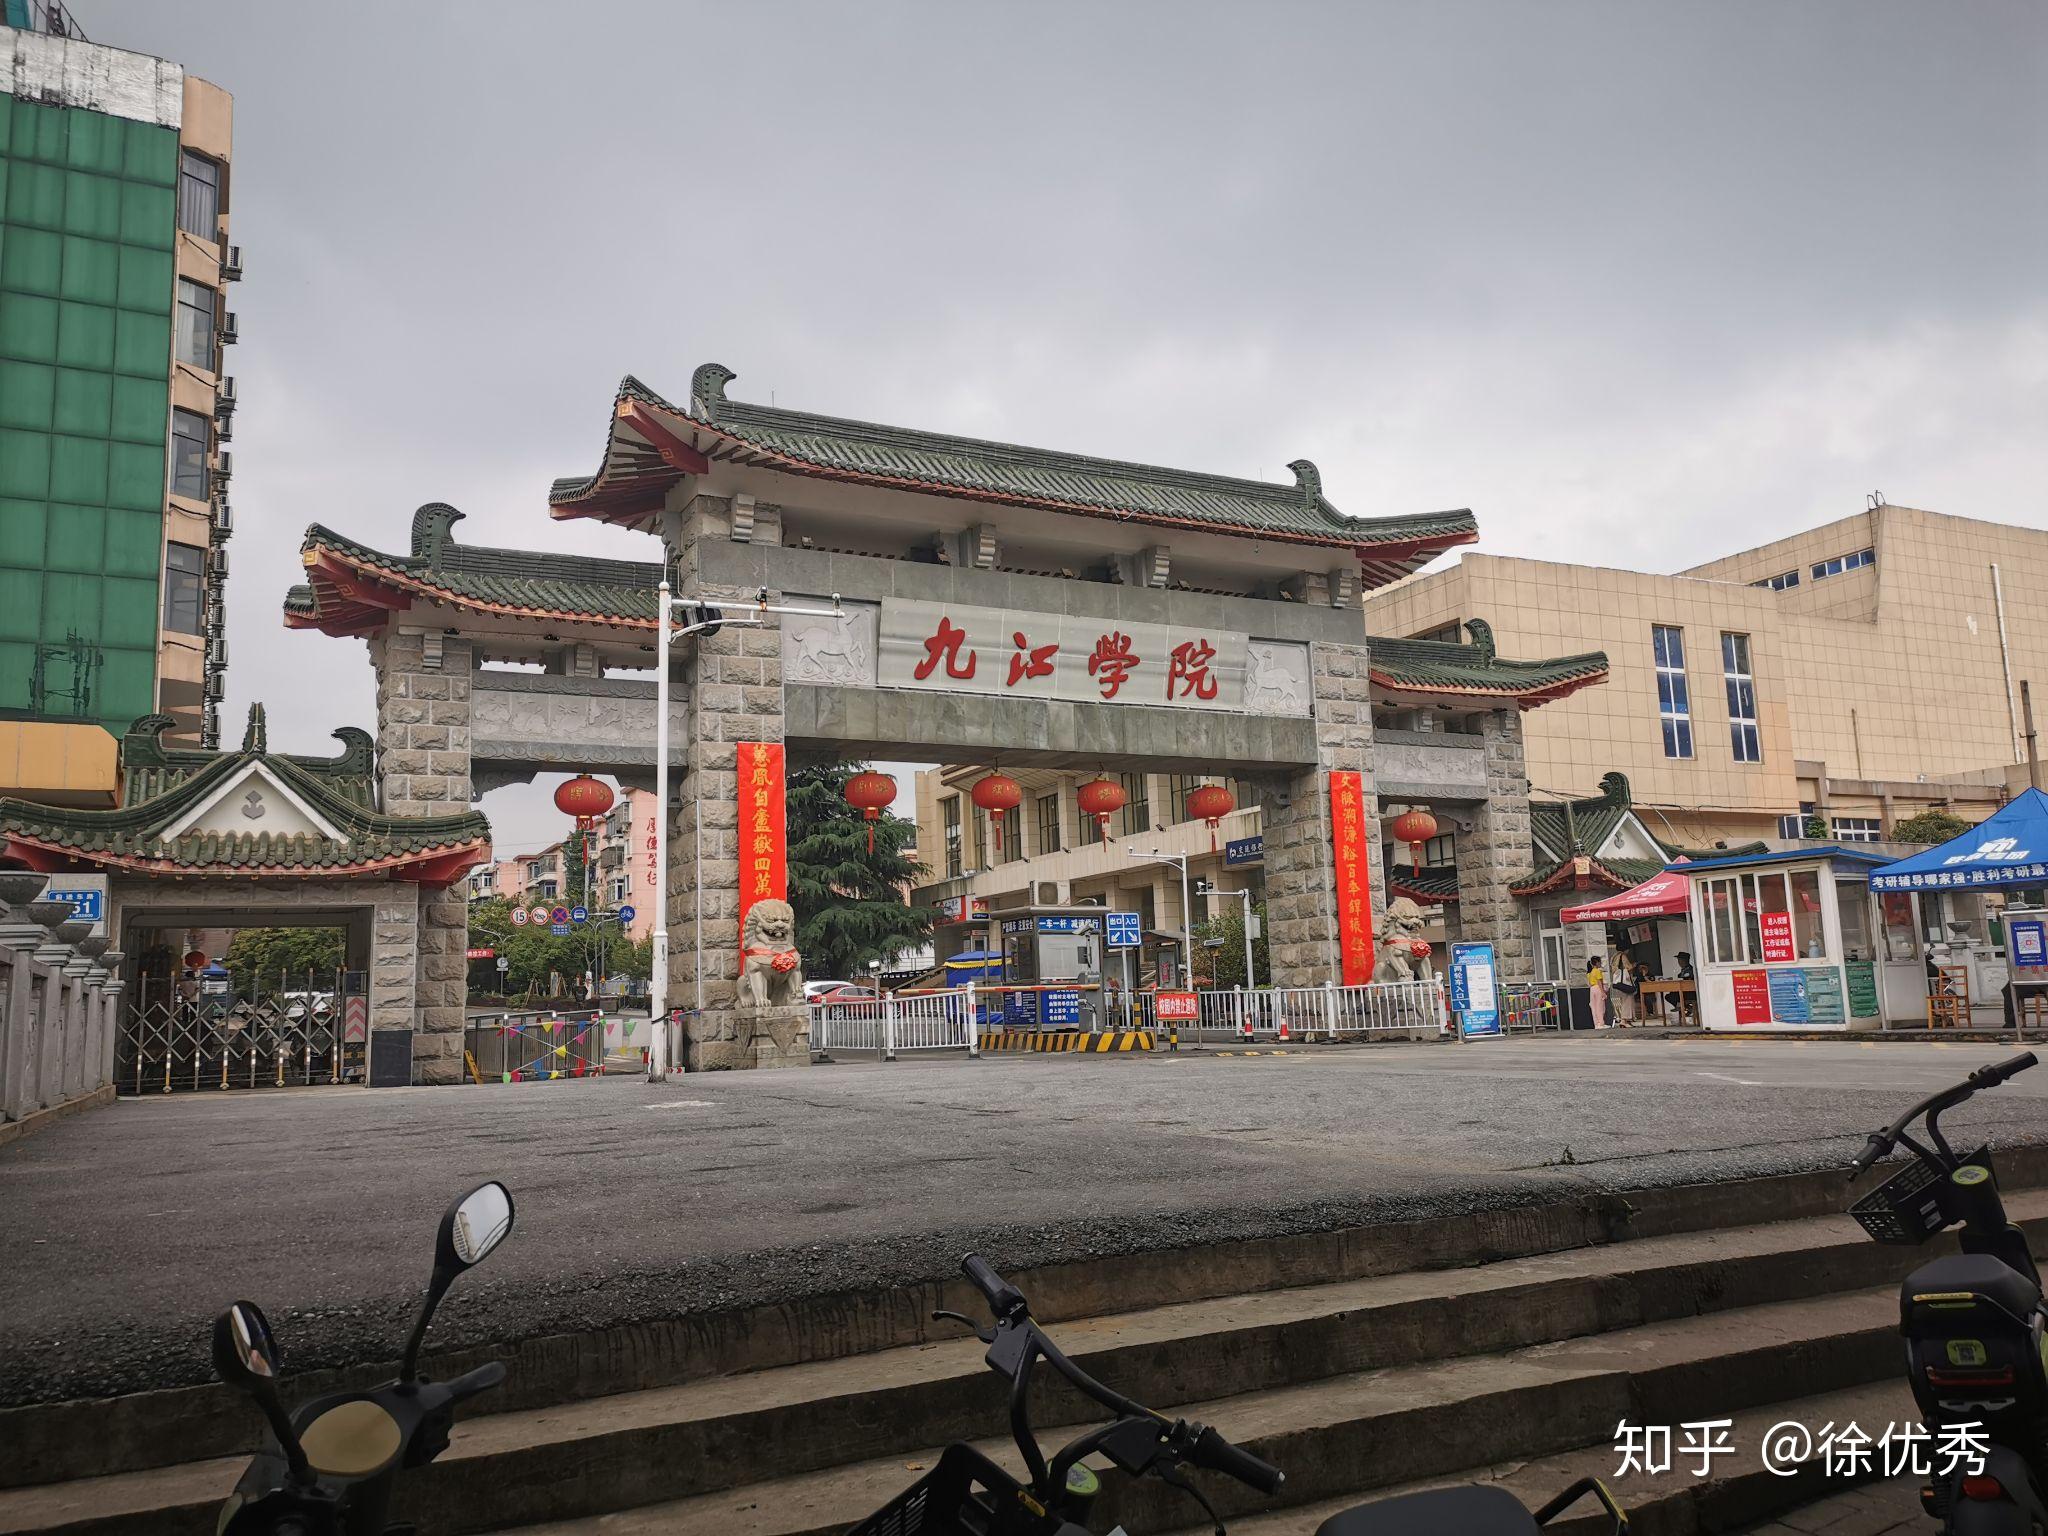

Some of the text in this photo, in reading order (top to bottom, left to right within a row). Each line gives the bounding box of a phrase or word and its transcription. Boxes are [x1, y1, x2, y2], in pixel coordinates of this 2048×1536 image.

[914, 617, 1217, 701] 九江學院
[1872, 863, 2048, 888] 考研辅导哪家强·胜利考研最
[515, 911, 525, 921] 15
[1039, 919, 1067, 928] 一车一杆
[1109, 918, 1138, 926] 出口 入口
[1453, 965, 1465, 999] 两轮车入口
